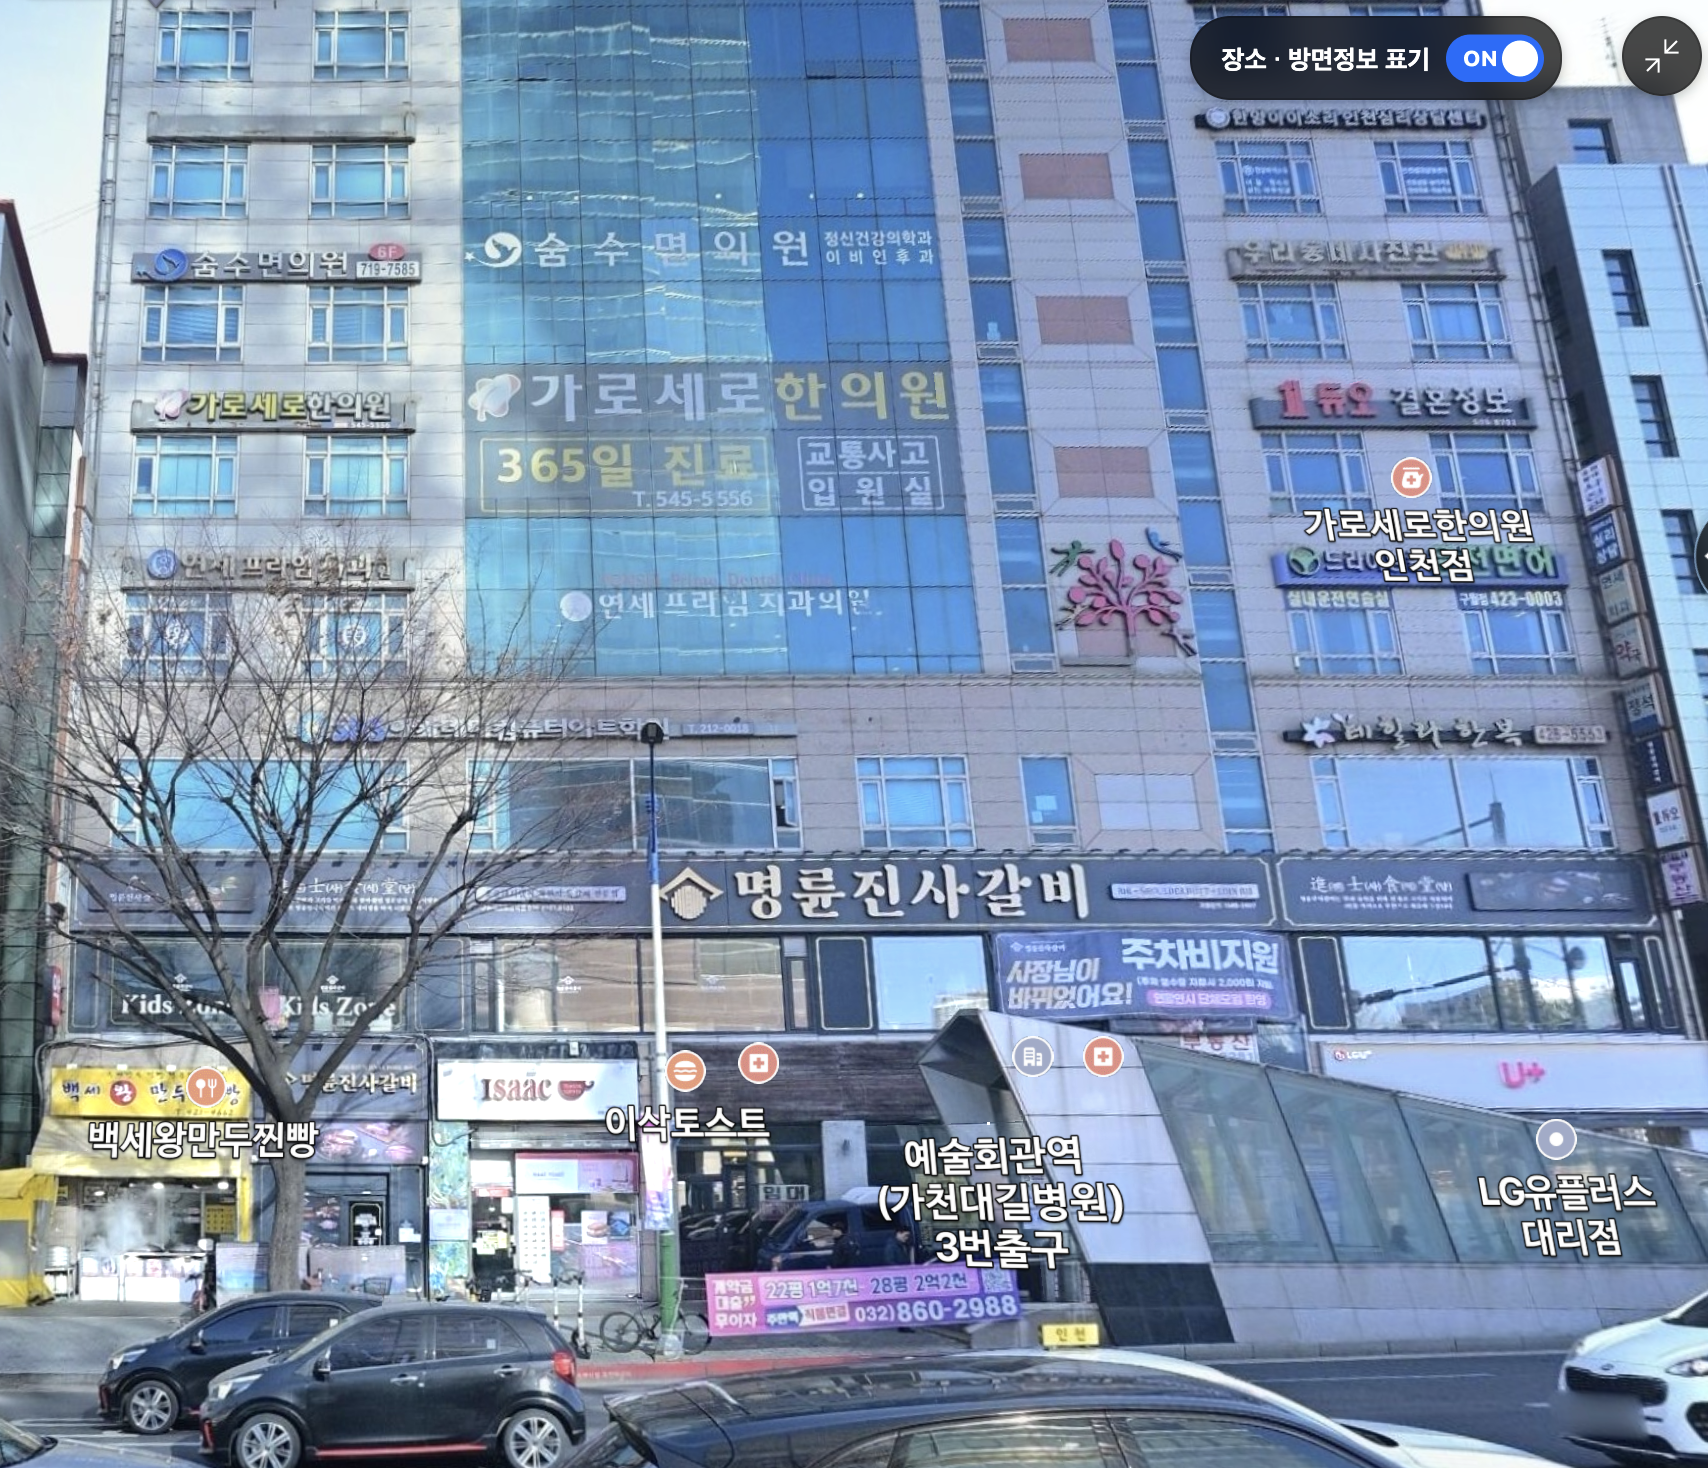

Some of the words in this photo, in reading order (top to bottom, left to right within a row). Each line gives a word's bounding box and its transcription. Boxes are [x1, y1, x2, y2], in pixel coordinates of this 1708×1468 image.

[377, 245, 397, 258] 6F
[823, 229, 933, 248] 정신건강의학과
[361, 262, 416, 276] 719-7585
[825, 247, 934, 266] 이비인후과
[189, 391, 392, 422] 가로세로한의원
[530, 369, 951, 423] 가로세로한의원
[1316, 381, 1377, 418] 듀오
[1389, 385, 1514, 417] 결혼정보
[496, 442, 634, 489] 365일
[665, 442, 753, 488] 진료
[805, 439, 931, 470] 교통사고
[807, 475, 933, 508] 입원실
[599, 589, 655, 620] 연세
[734, 863, 1092, 921] 명륜진사갈비
[1005, 956, 1102, 984] 사장님이
[1121, 937, 1279, 975] 주차비지원
[1500, 1061, 1546, 1089] U+
